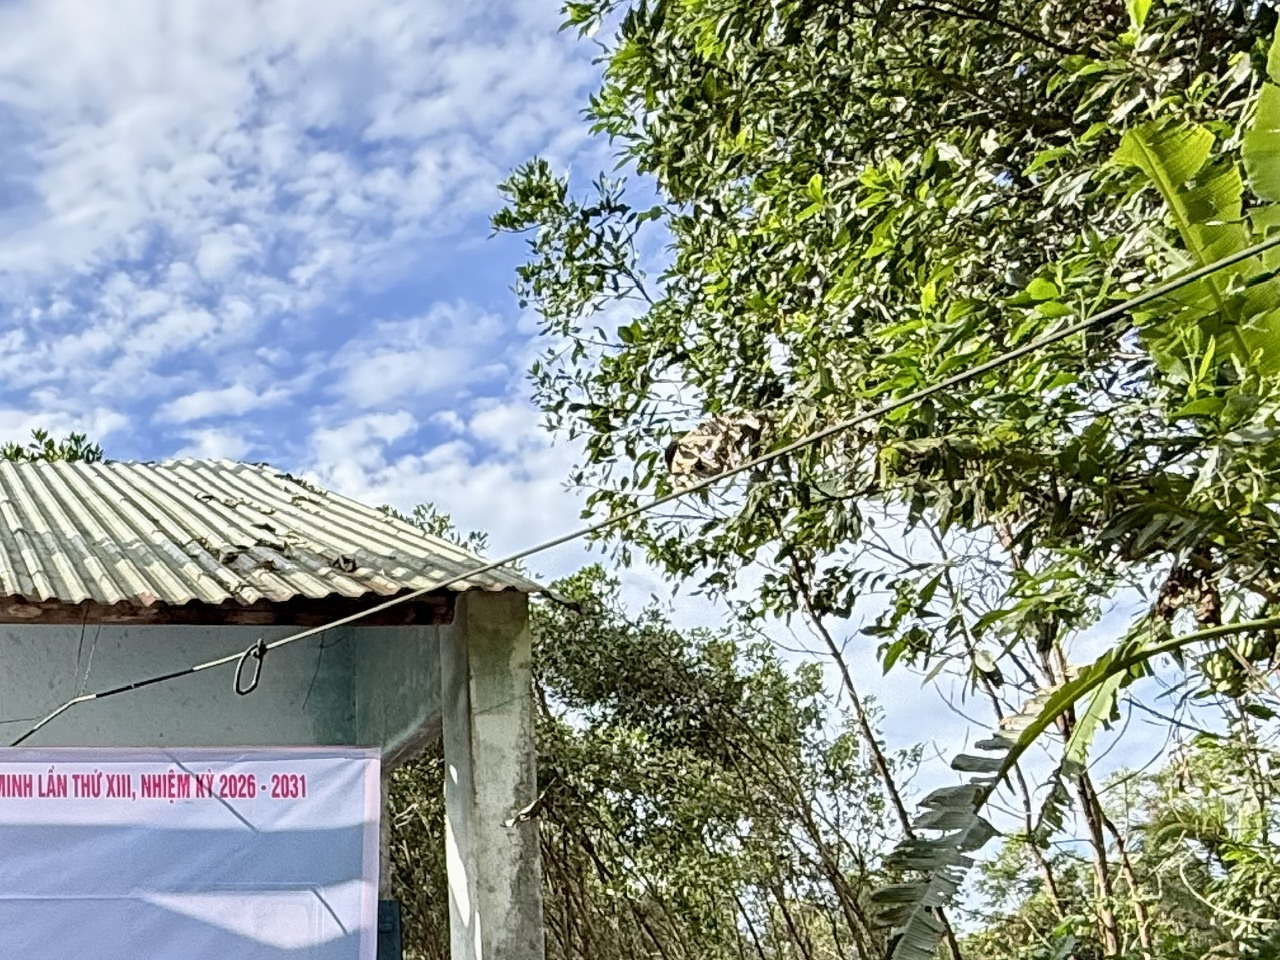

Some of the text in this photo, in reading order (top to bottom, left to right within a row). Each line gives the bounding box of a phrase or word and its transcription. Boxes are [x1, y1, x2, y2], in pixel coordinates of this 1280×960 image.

[38, 766, 68, 798] LẦN
[72, 769, 103, 798] THỨ
[106, 774, 136, 800] XIII,
[141, 769, 191, 804] NHIỆM
[196, 769, 214, 798] KỲ
[219, 774, 256, 798] 2026
[271, 774, 306, 798] 2031
